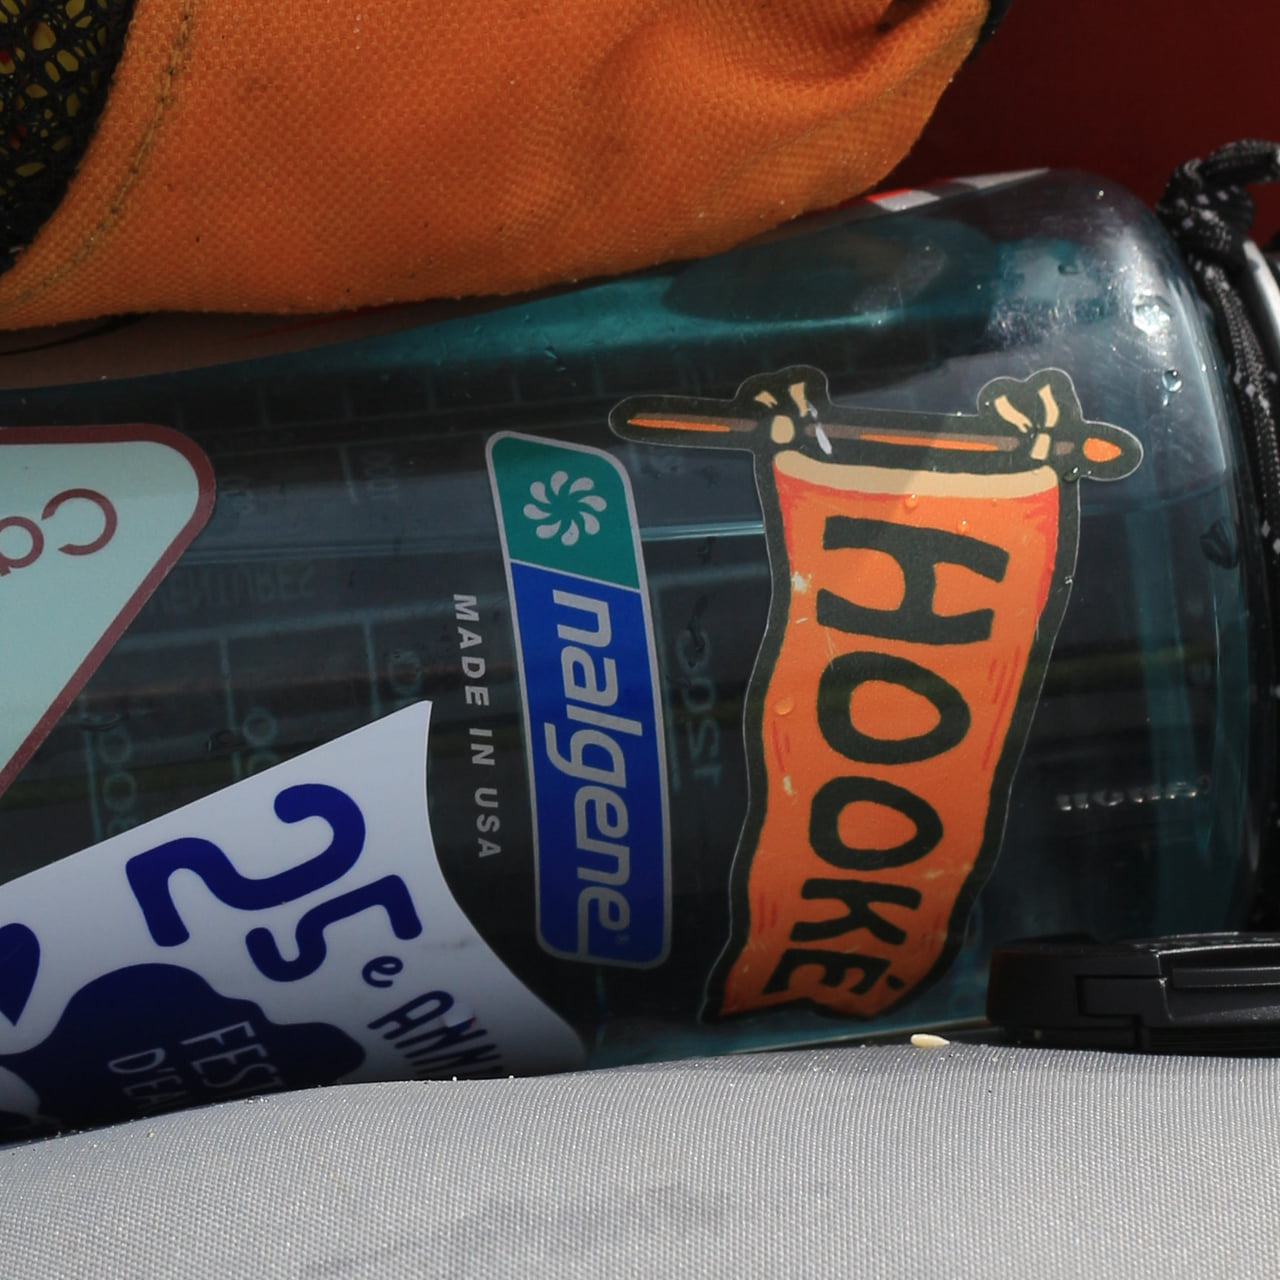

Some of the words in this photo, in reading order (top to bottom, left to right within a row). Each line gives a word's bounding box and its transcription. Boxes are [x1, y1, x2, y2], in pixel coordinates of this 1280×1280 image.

[453, 593, 491, 708] MADE
[469, 727, 496, 767] IN
[543, 588, 644, 935] nalgene
[761, 514, 1010, 997] HOOKÉ
[473, 787, 502, 860] USA
